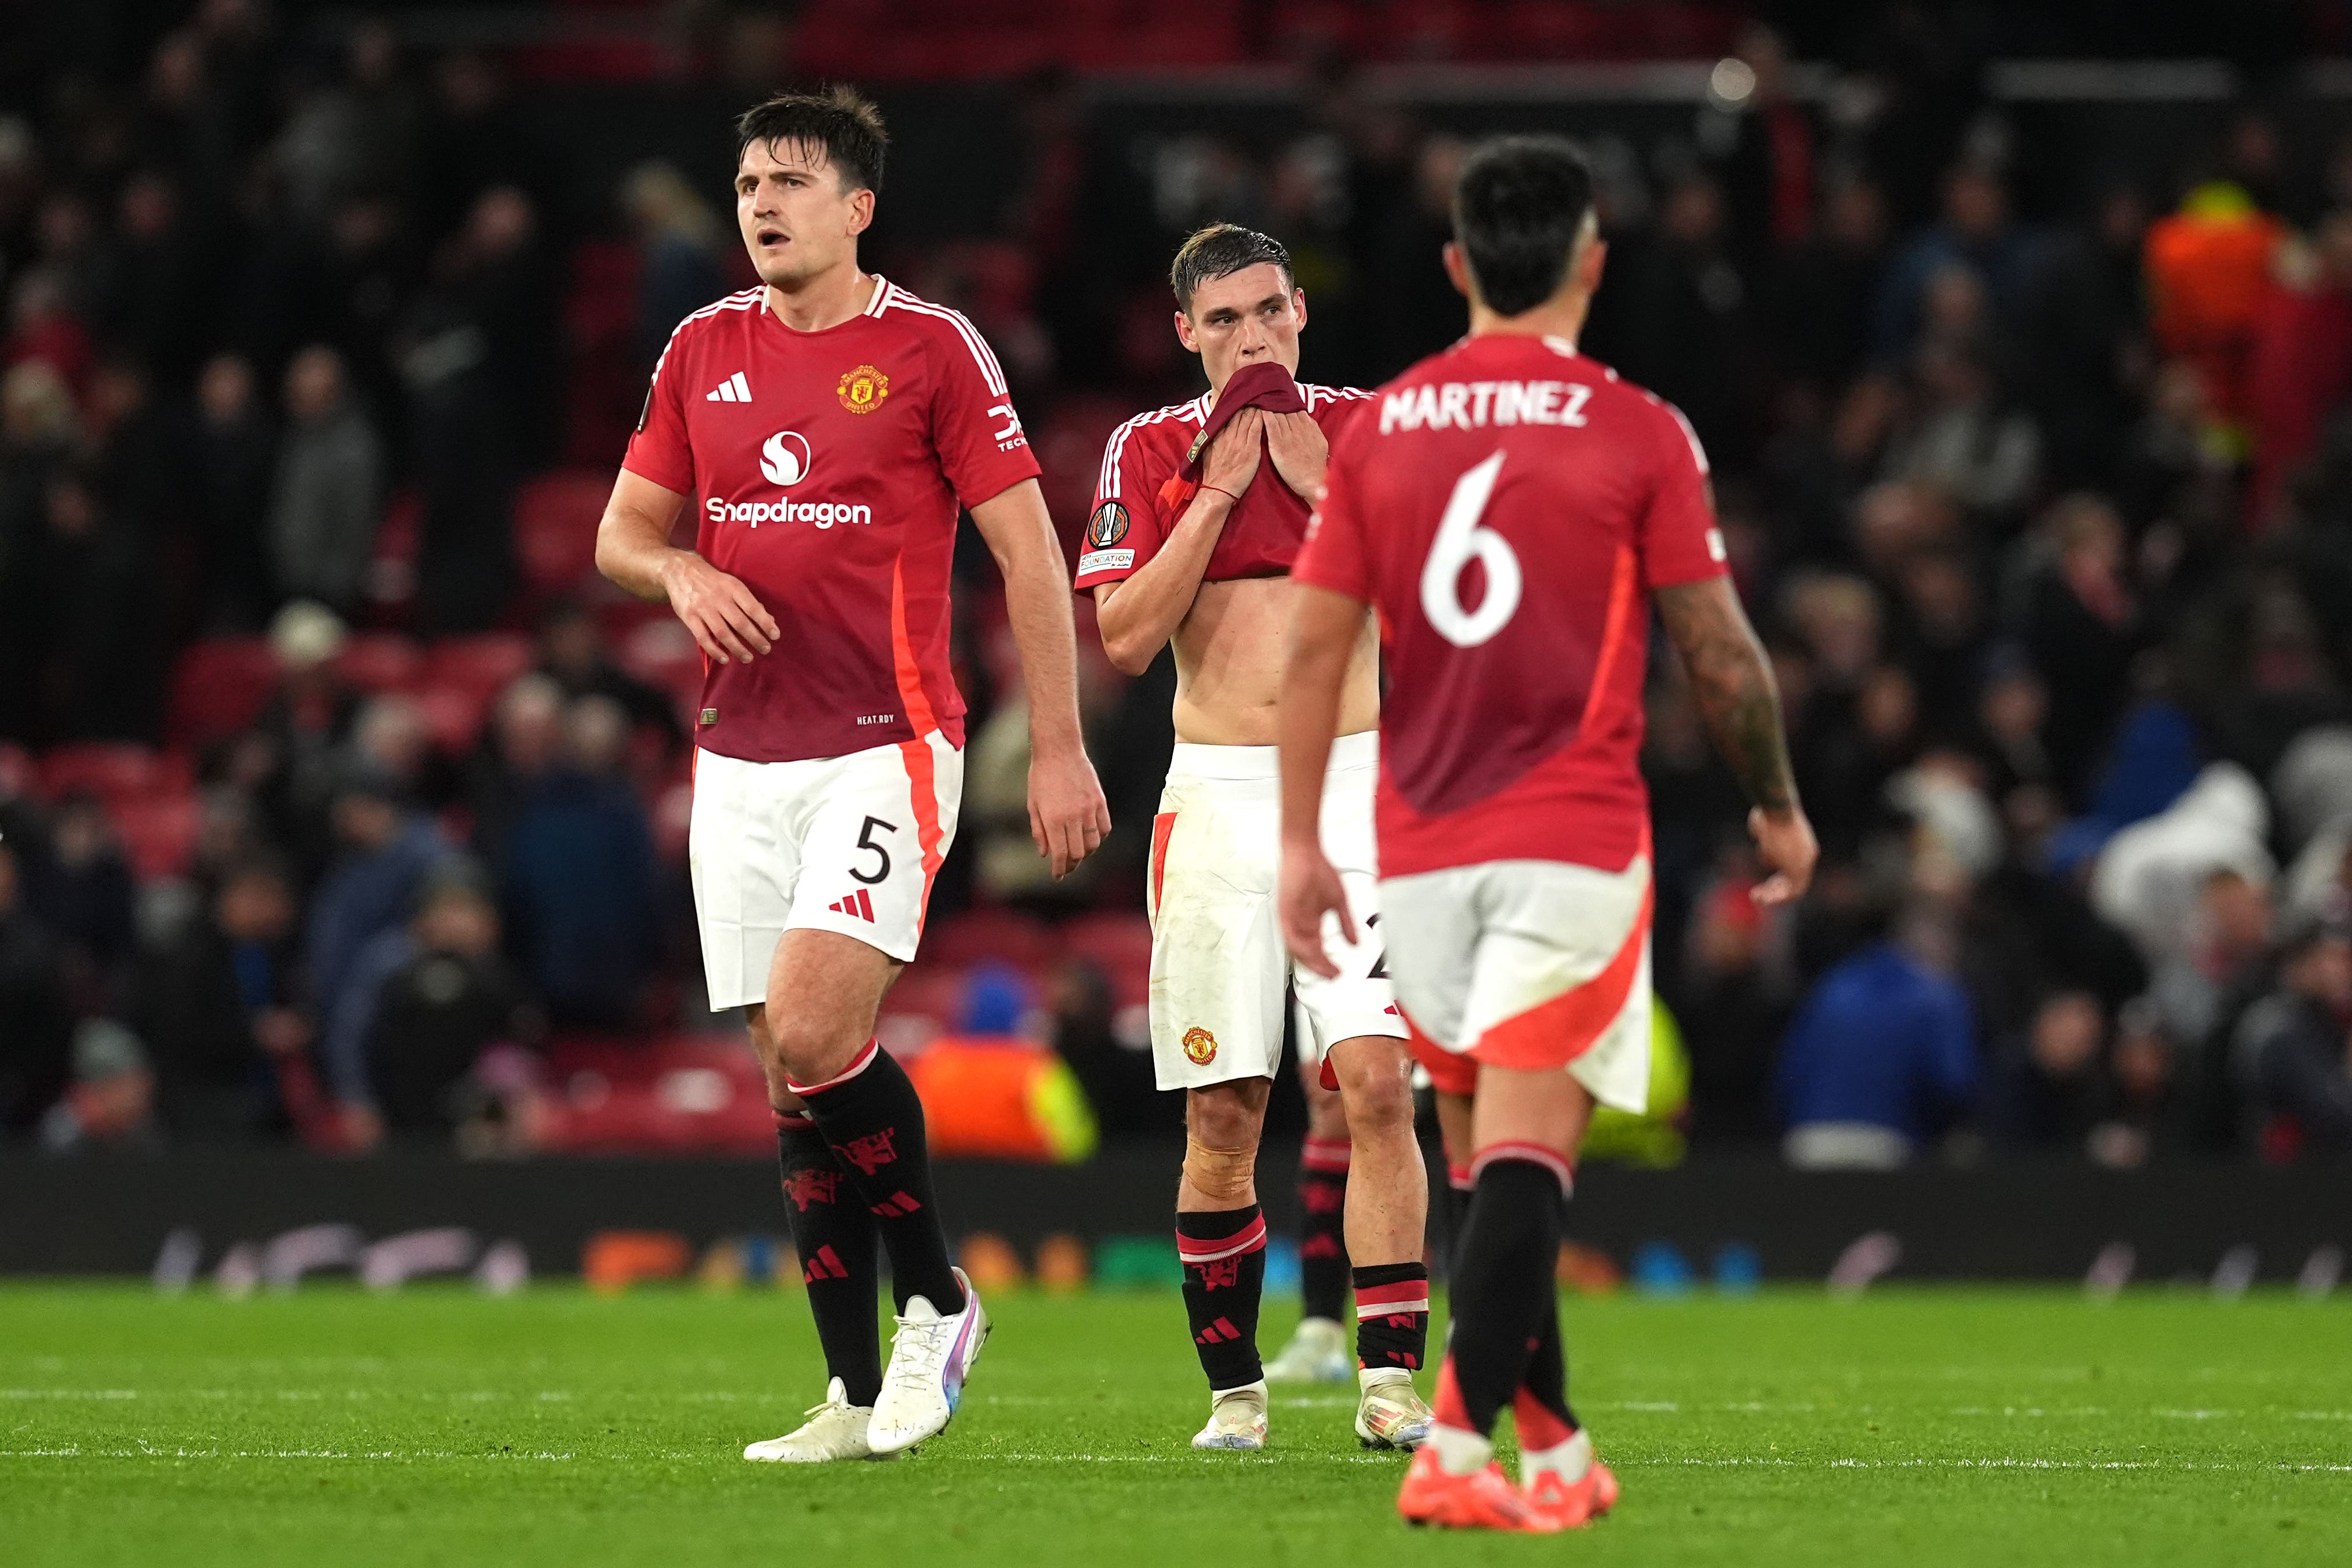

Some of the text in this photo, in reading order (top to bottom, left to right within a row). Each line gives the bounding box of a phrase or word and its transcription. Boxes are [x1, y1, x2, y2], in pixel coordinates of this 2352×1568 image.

[1379, 380, 1593, 435] MARTINEZ
[707, 496, 871, 529] Snapdragon
[1081, 555, 1132, 567] FOUNDATION
[1420, 449, 1523, 648] 6
[857, 714, 894, 725] HEAT.RDY
[848, 815, 898, 884] 5
